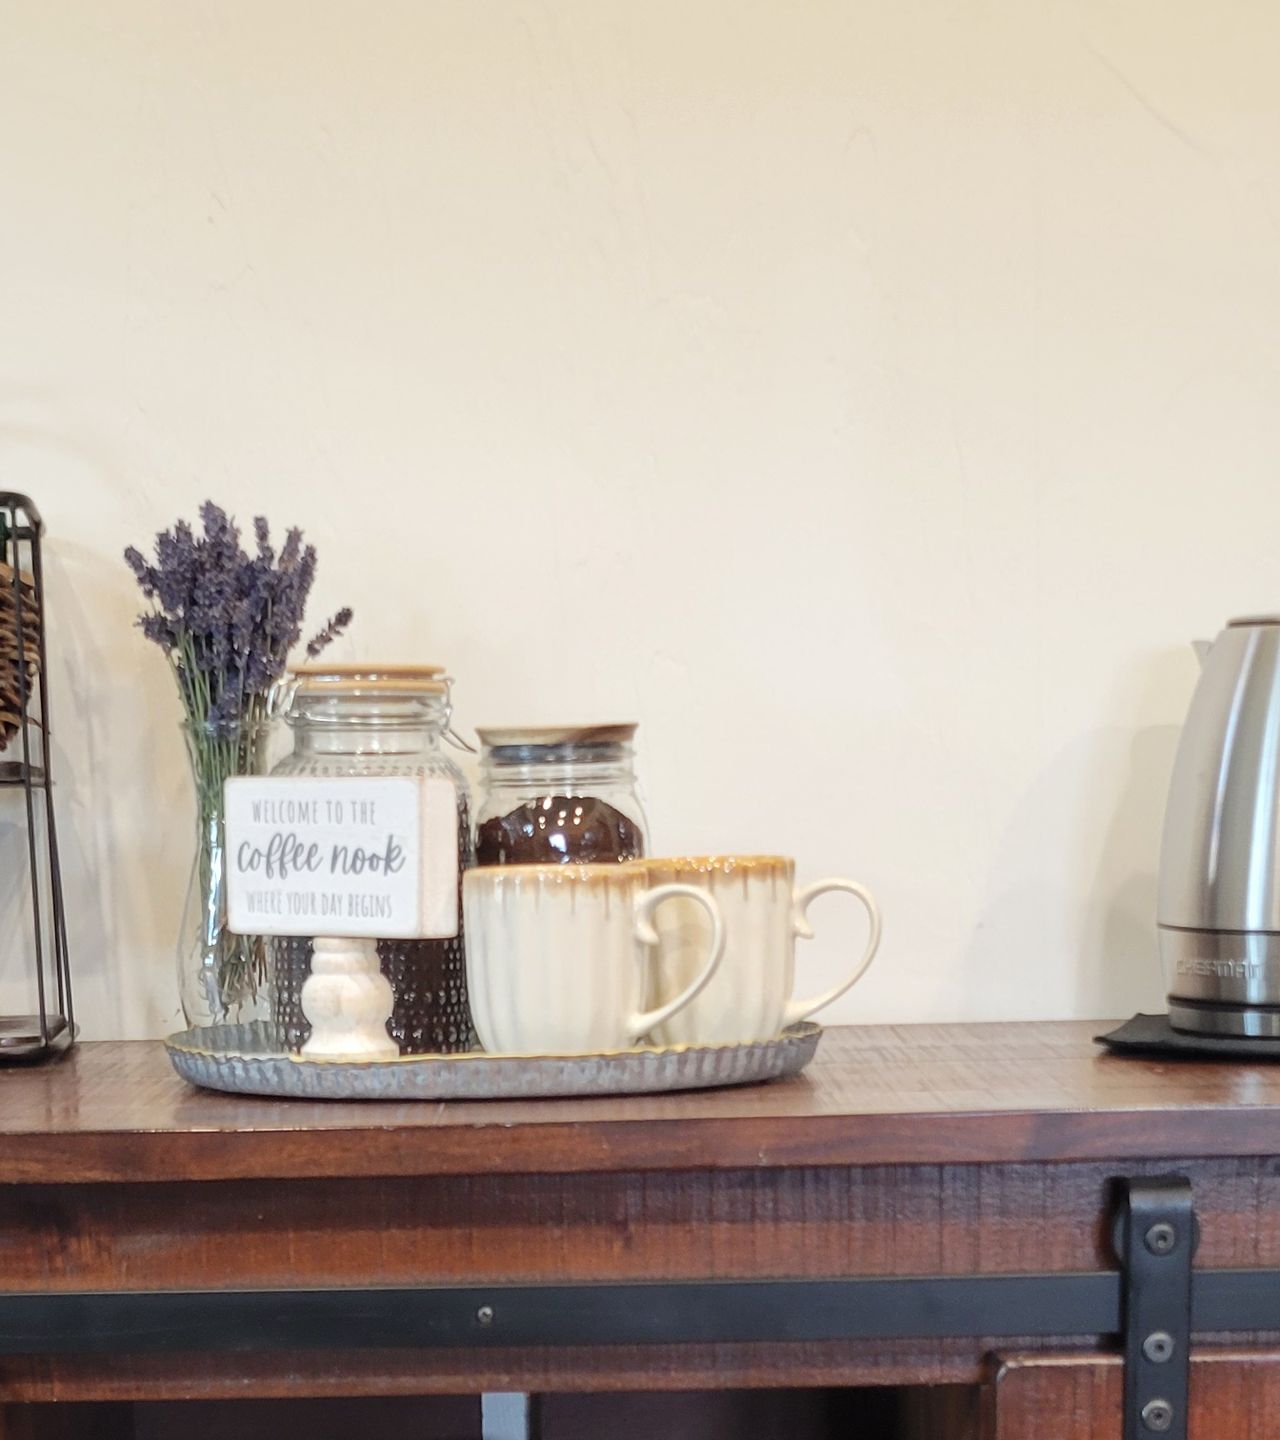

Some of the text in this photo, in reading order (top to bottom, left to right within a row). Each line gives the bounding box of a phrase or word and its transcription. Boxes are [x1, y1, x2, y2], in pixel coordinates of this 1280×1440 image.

[252, 800, 376, 824] WELCOME TO THE
[237, 832, 406, 880] coffee nook
[246, 891, 392, 918] WHERE YOUR DAY BEGINS
